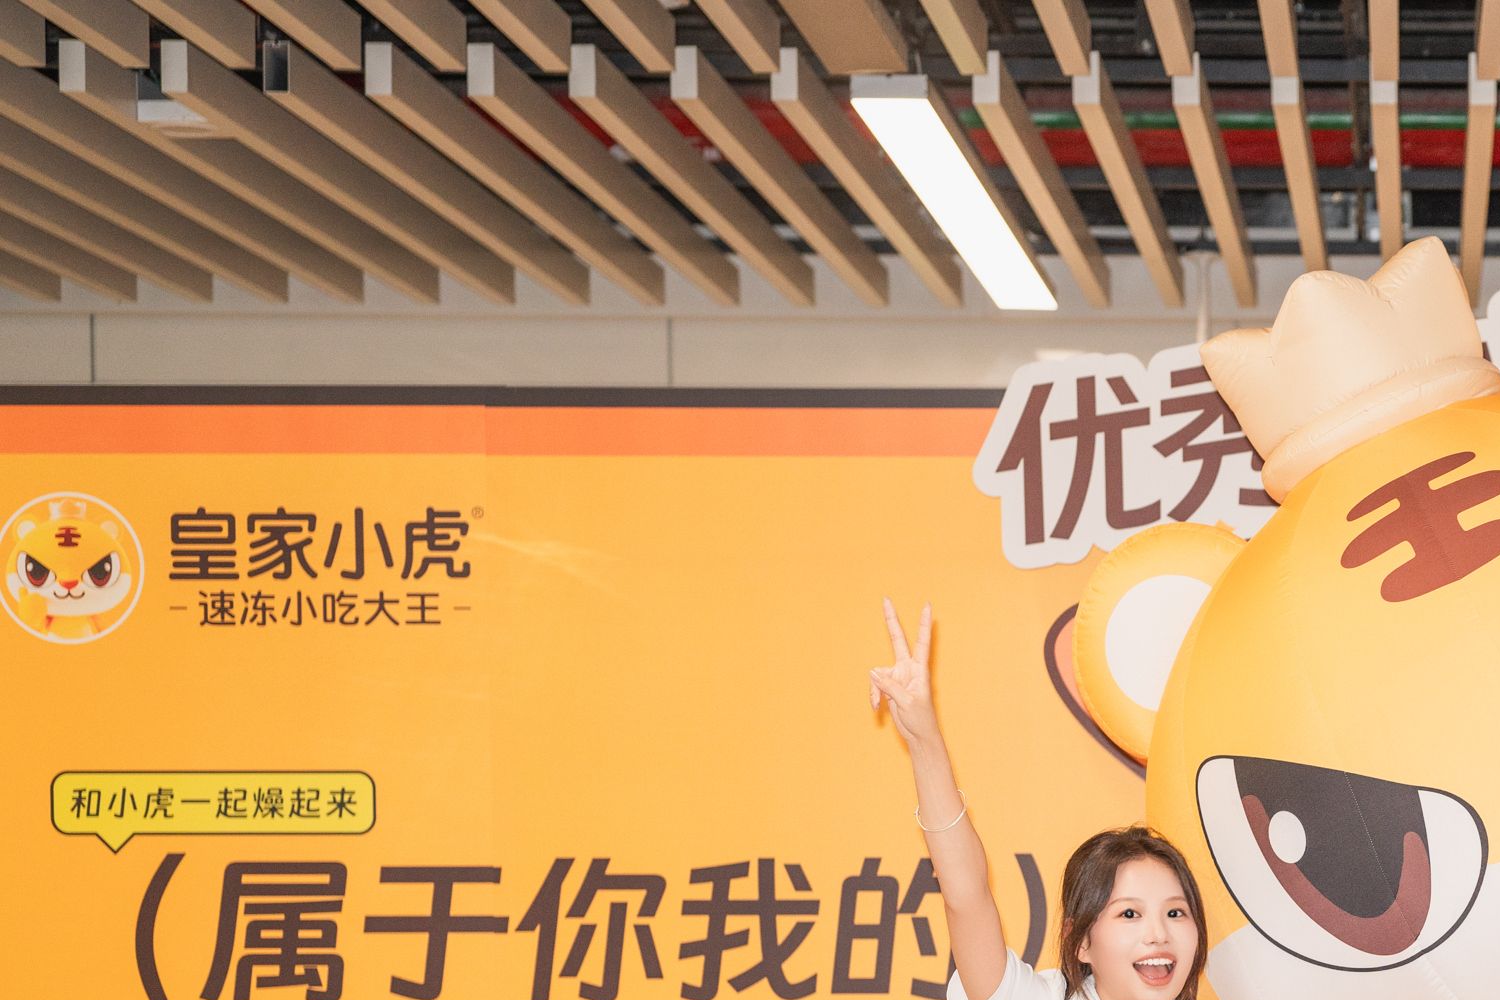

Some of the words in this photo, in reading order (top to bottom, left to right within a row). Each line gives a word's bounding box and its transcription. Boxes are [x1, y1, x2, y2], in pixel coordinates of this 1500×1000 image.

[169, 506, 472, 581] 皇家小虎
[197, 590, 442, 627] 速冻小吃大王
[70, 787, 358, 820] 和小虎一起燥起来
